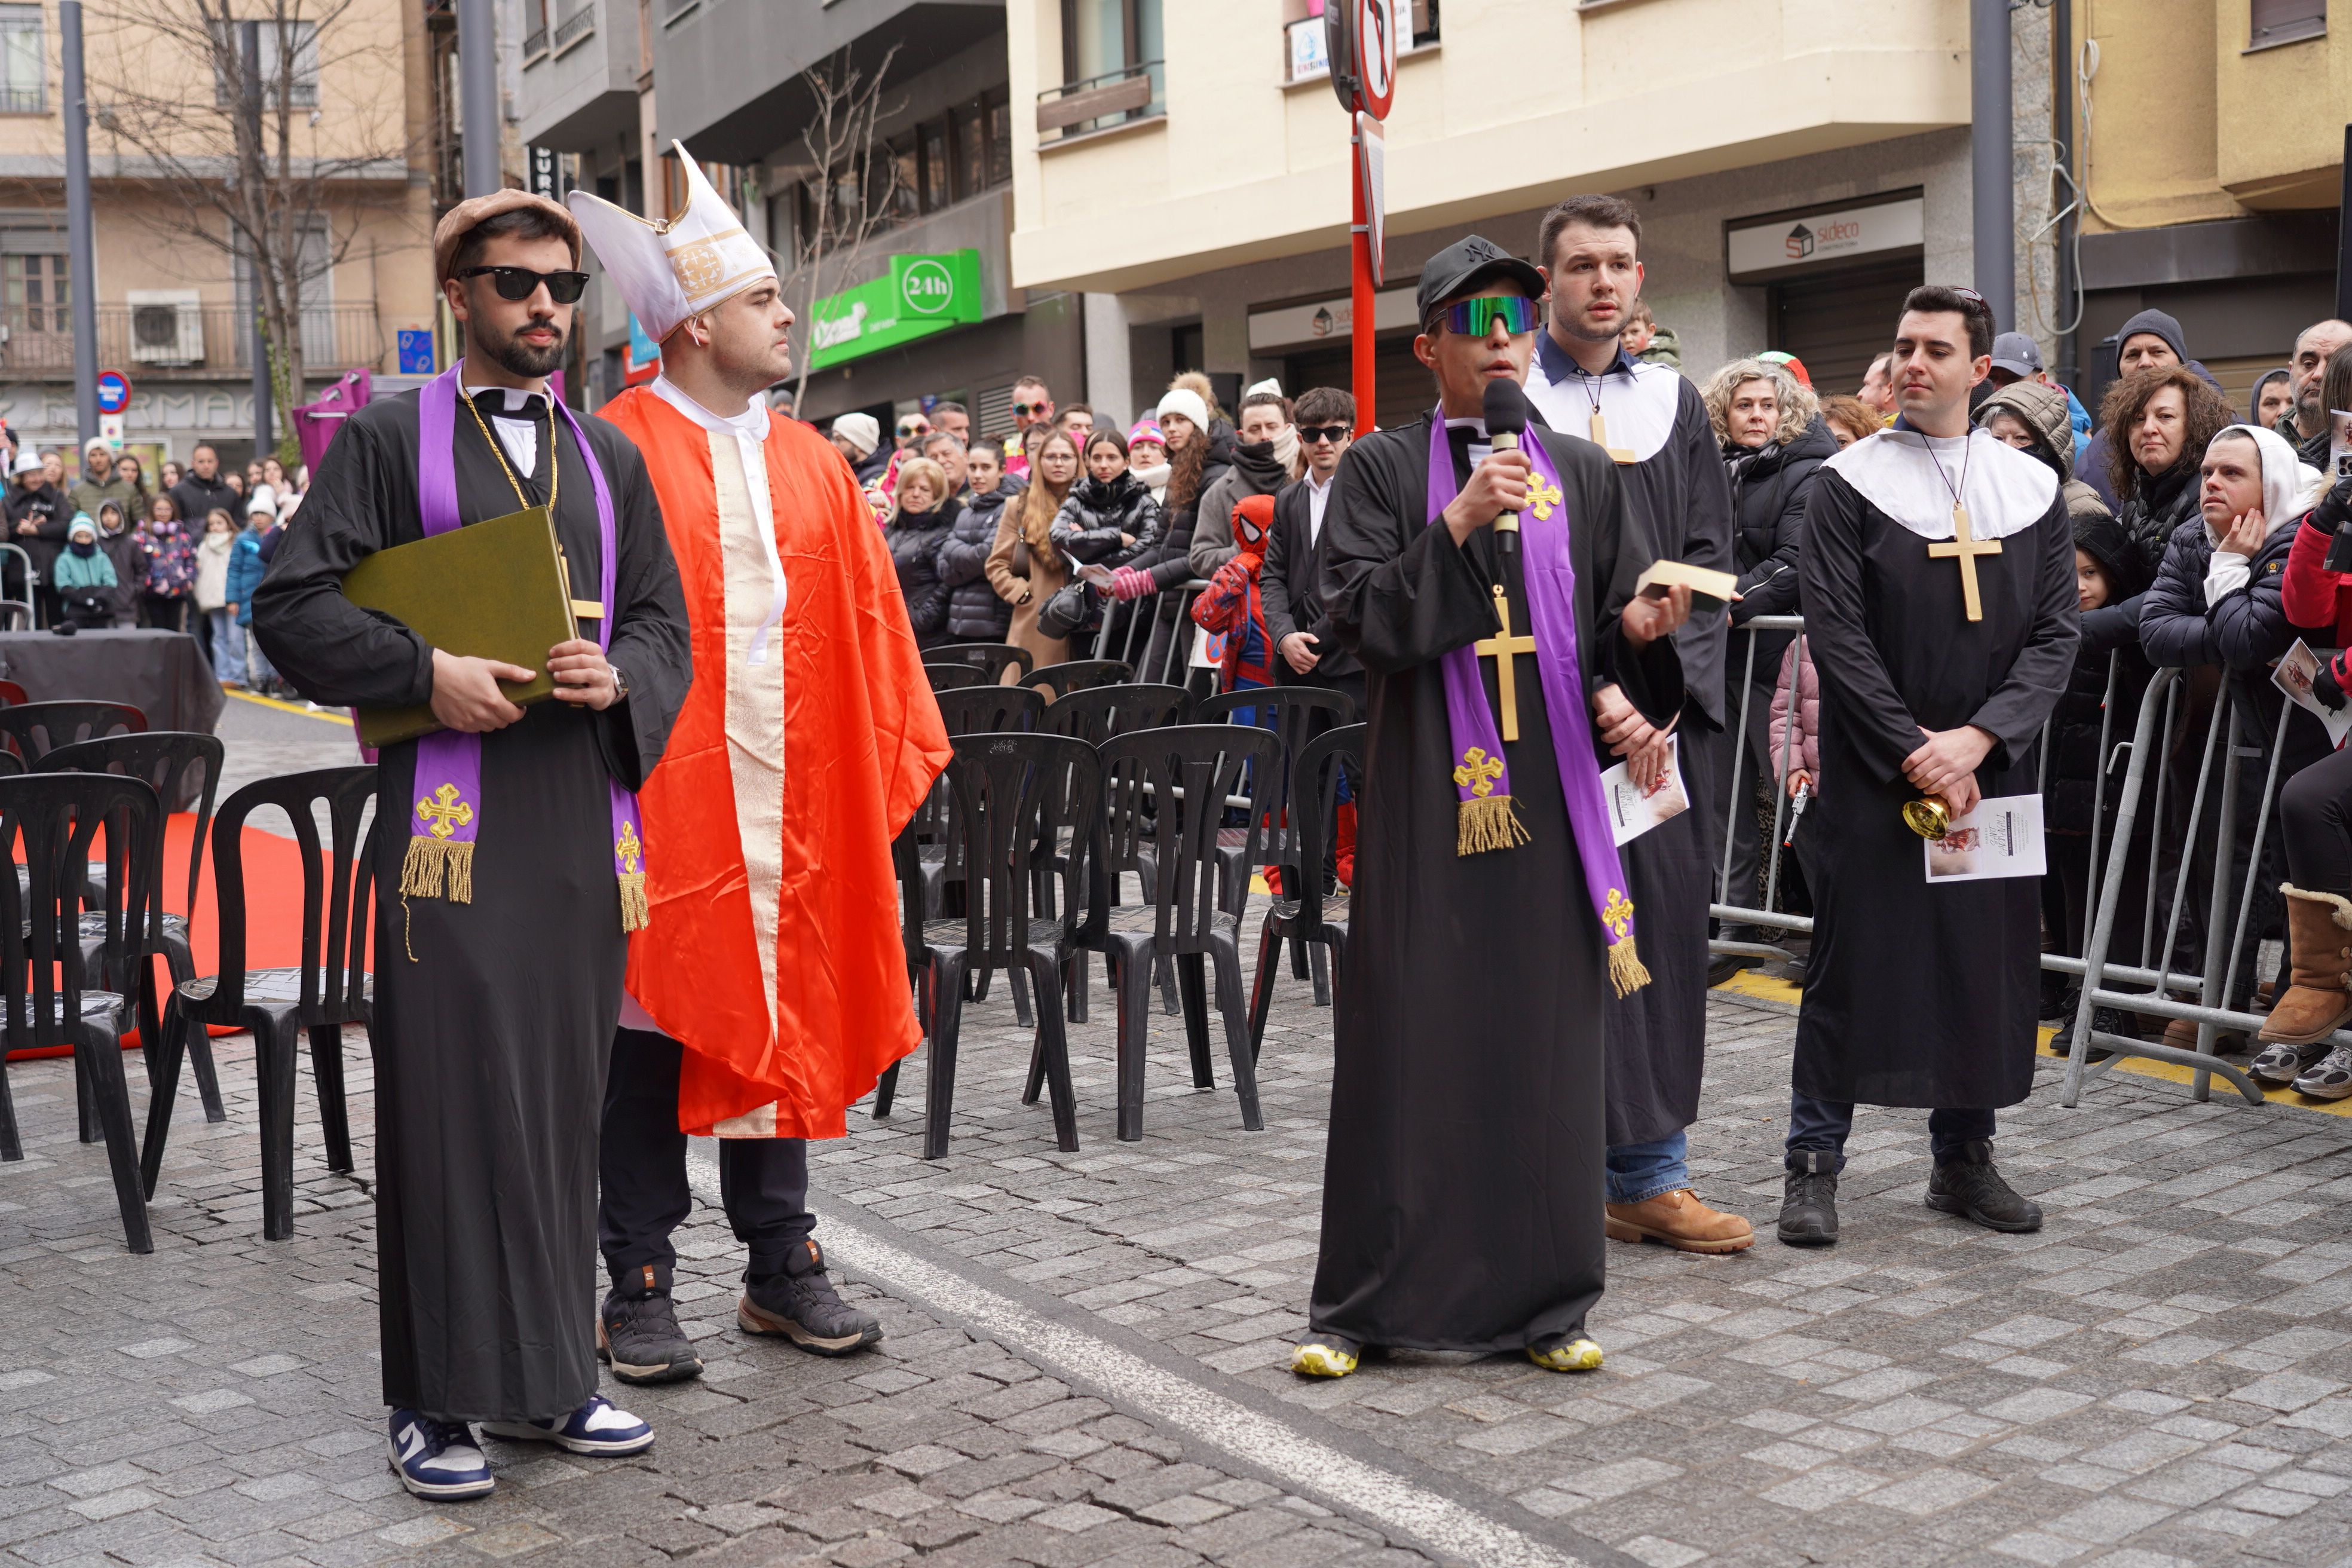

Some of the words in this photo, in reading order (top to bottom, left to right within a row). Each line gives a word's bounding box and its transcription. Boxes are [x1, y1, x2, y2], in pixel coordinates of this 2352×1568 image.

[1817, 220, 1859, 243] sideco
[908, 276, 948, 295] 24h
[1989, 822, 1998, 846] SANT
